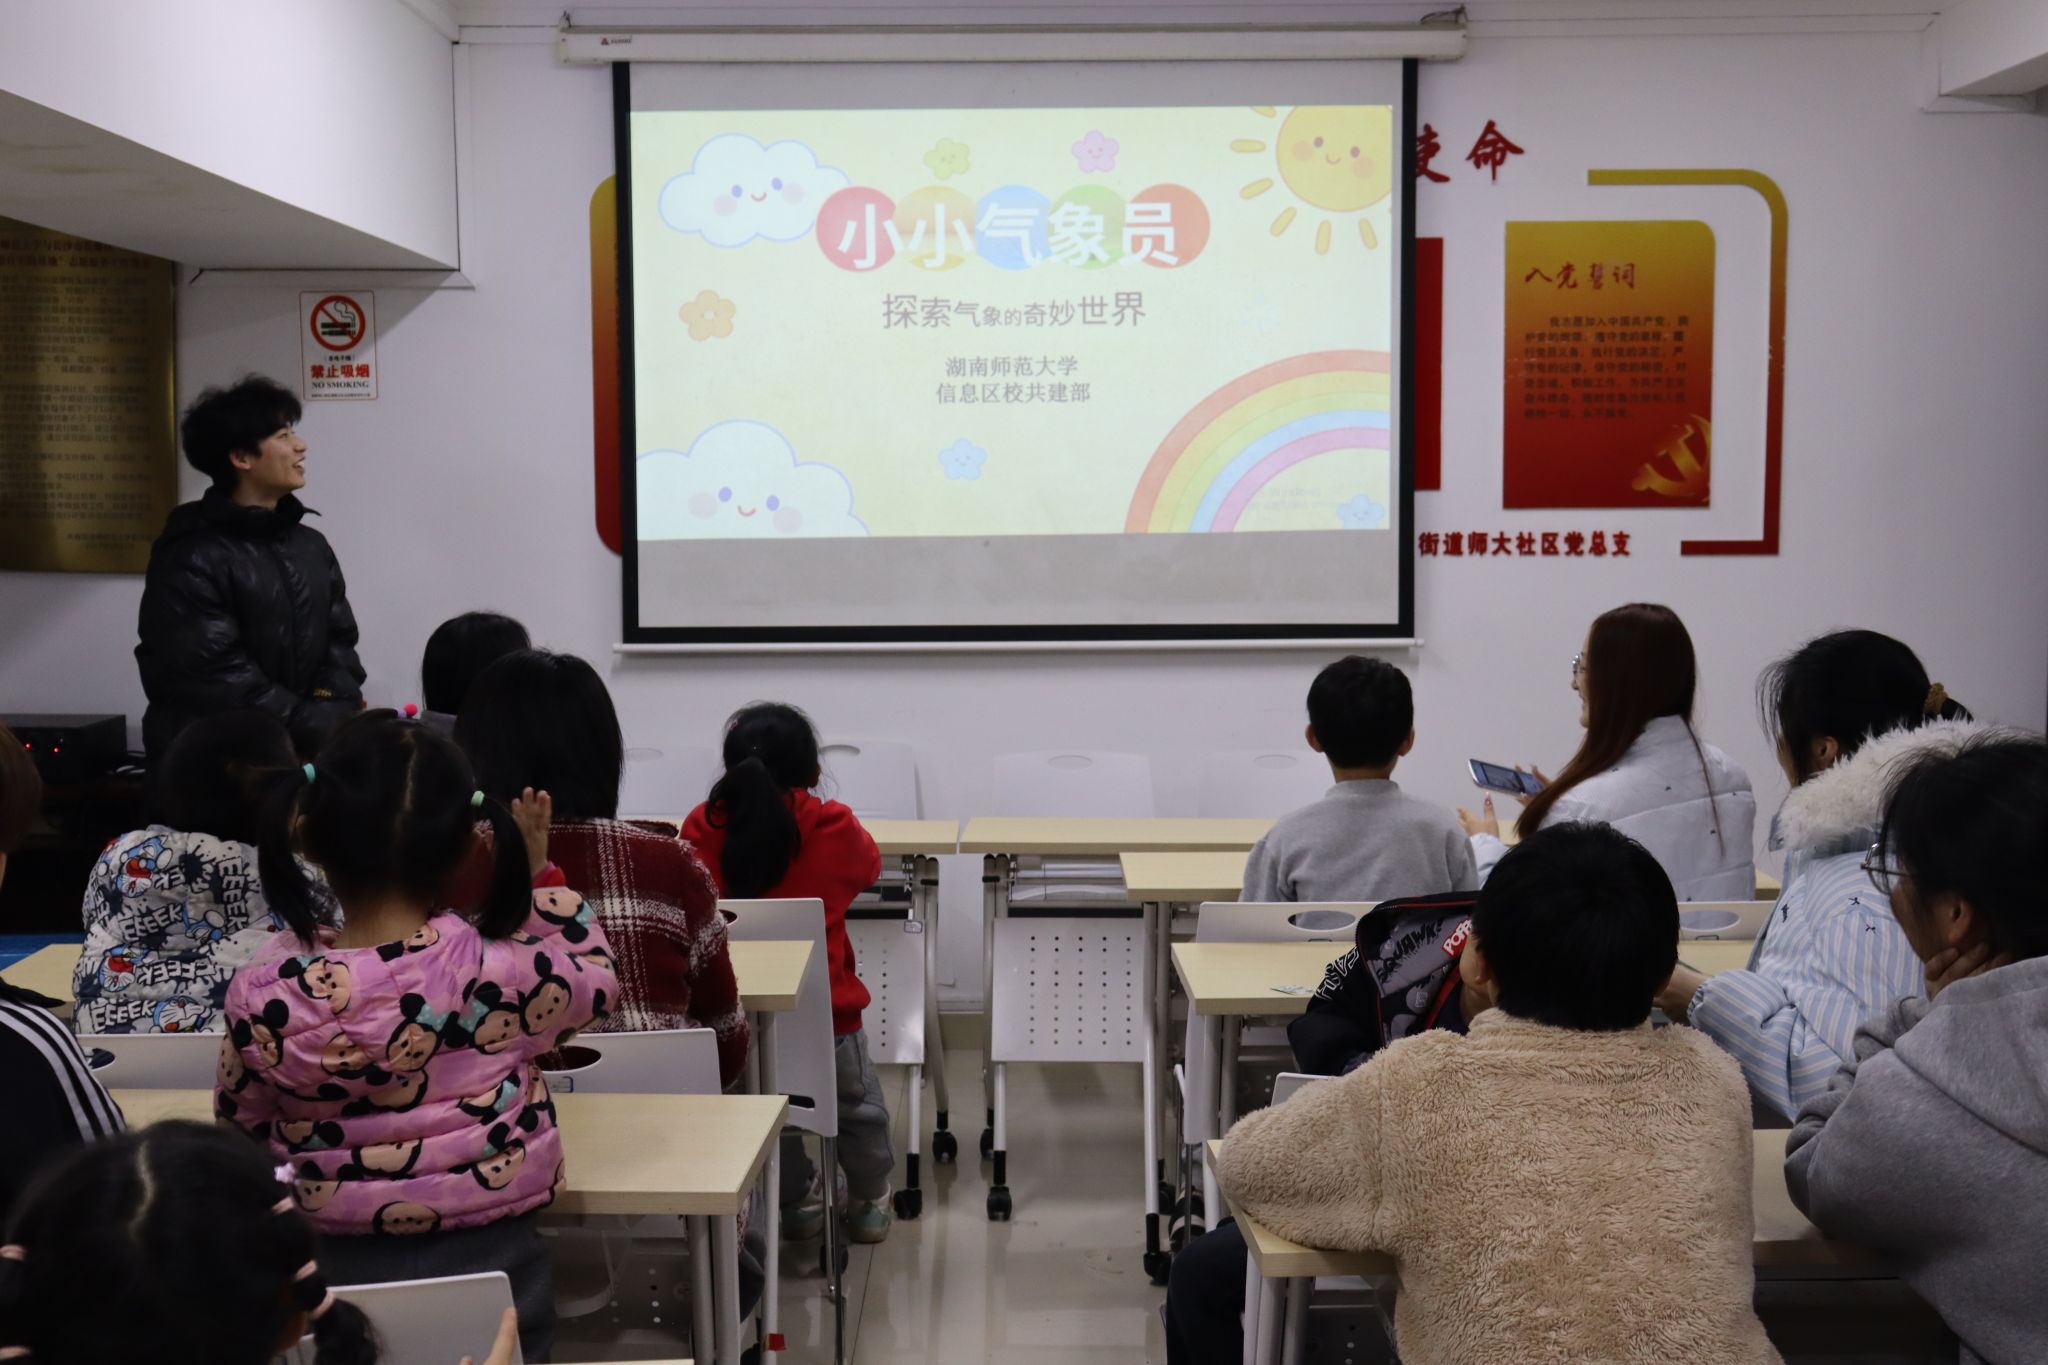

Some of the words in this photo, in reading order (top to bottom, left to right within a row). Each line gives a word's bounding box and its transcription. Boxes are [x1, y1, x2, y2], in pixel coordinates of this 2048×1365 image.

[838, 202, 1179, 269] 小小气象员
[1524, 260, 1637, 290] 入党誓词
[882, 291, 1146, 329] 探索气象的奇妙世界
[310, 363, 370, 379] 禁止吸烟
[945, 355, 1078, 377] 湖南师范大学
[326, 380, 369, 388] SMOKING
[936, 382, 1091, 404] 信息区校共建部
[1418, 531, 1631, 556] 街道师大社区党总支
[118, 903, 184, 942] EEEEK
[91, 1000, 156, 1033] EEEEK
